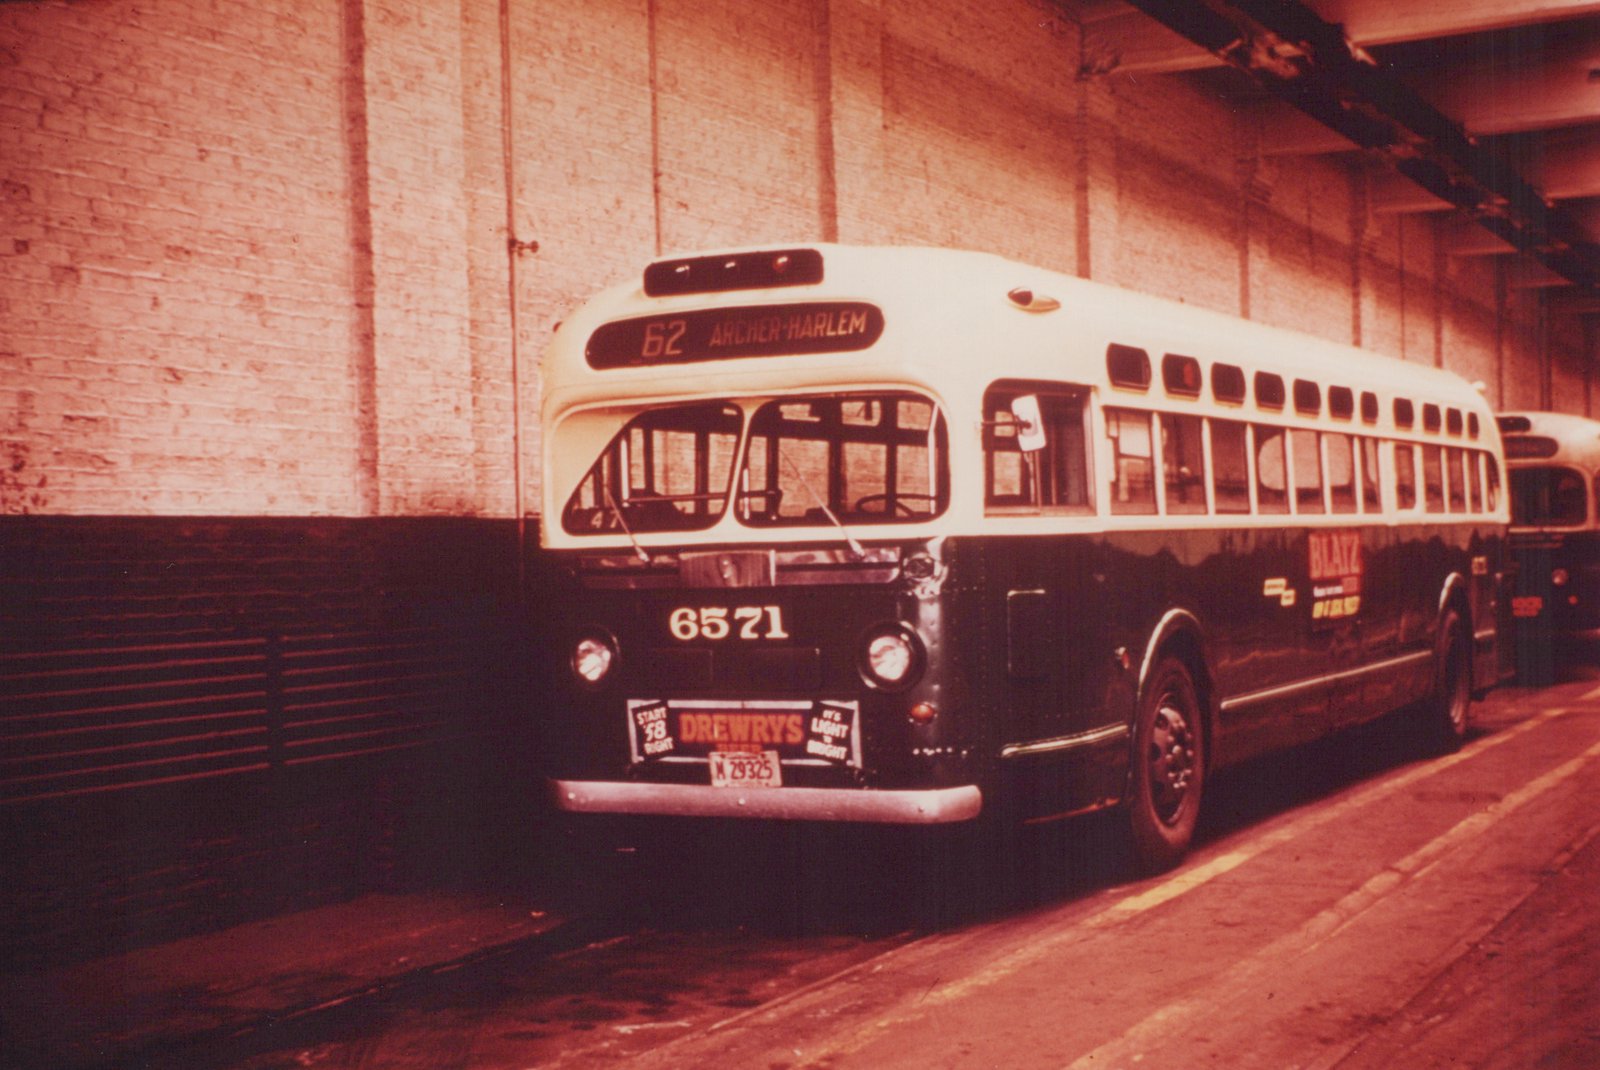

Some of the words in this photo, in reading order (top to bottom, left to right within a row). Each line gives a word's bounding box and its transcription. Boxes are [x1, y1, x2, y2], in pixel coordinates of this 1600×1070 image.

[641, 319, 687, 358] 62
[709, 311, 868, 348] ARCHER-HARLEM
[1308, 532, 1361, 580] BLATZ
[669, 605, 790, 641] 6571
[636, 707, 668, 726] START
[678, 713, 805, 743] DREWRYS
[811, 717, 849, 739] LIGHT
[729, 760, 773, 780] 29325
